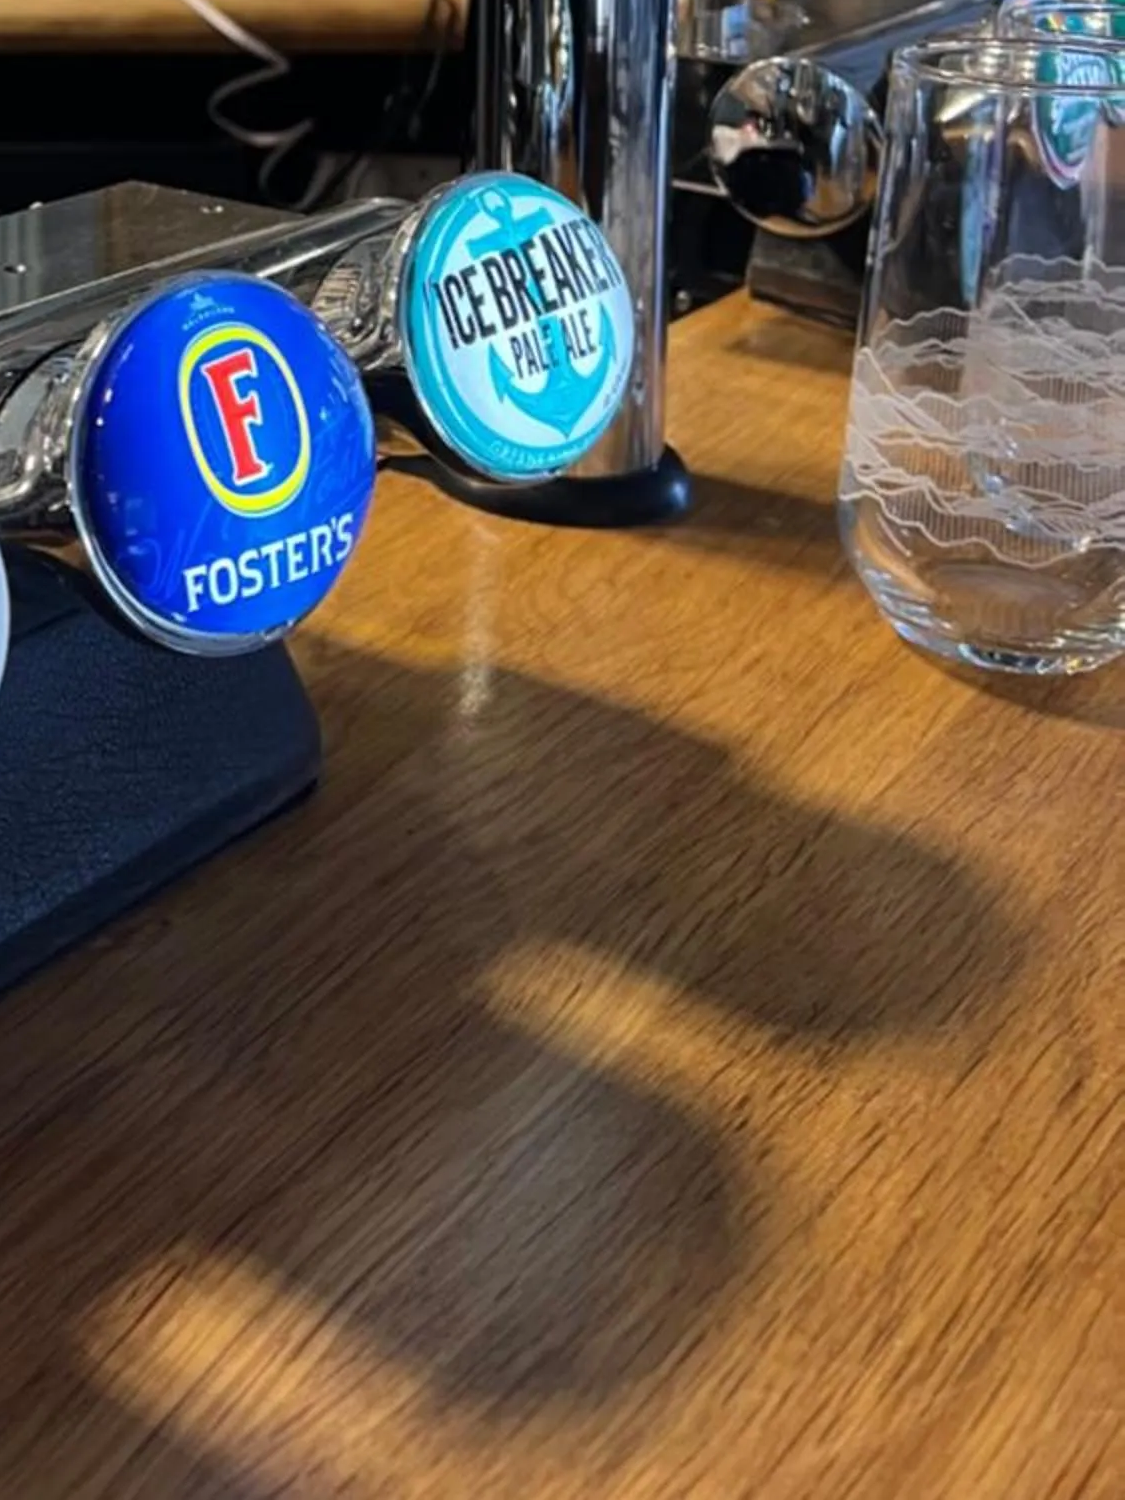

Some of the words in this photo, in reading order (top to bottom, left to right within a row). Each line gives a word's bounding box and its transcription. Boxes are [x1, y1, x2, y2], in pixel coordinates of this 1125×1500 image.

[433, 264, 497, 352] ICE
[508, 322, 560, 381] PALE
[559, 308, 598, 360] ALE
[200, 347, 264, 487] F
[183, 512, 355, 614] FOSTER'S
